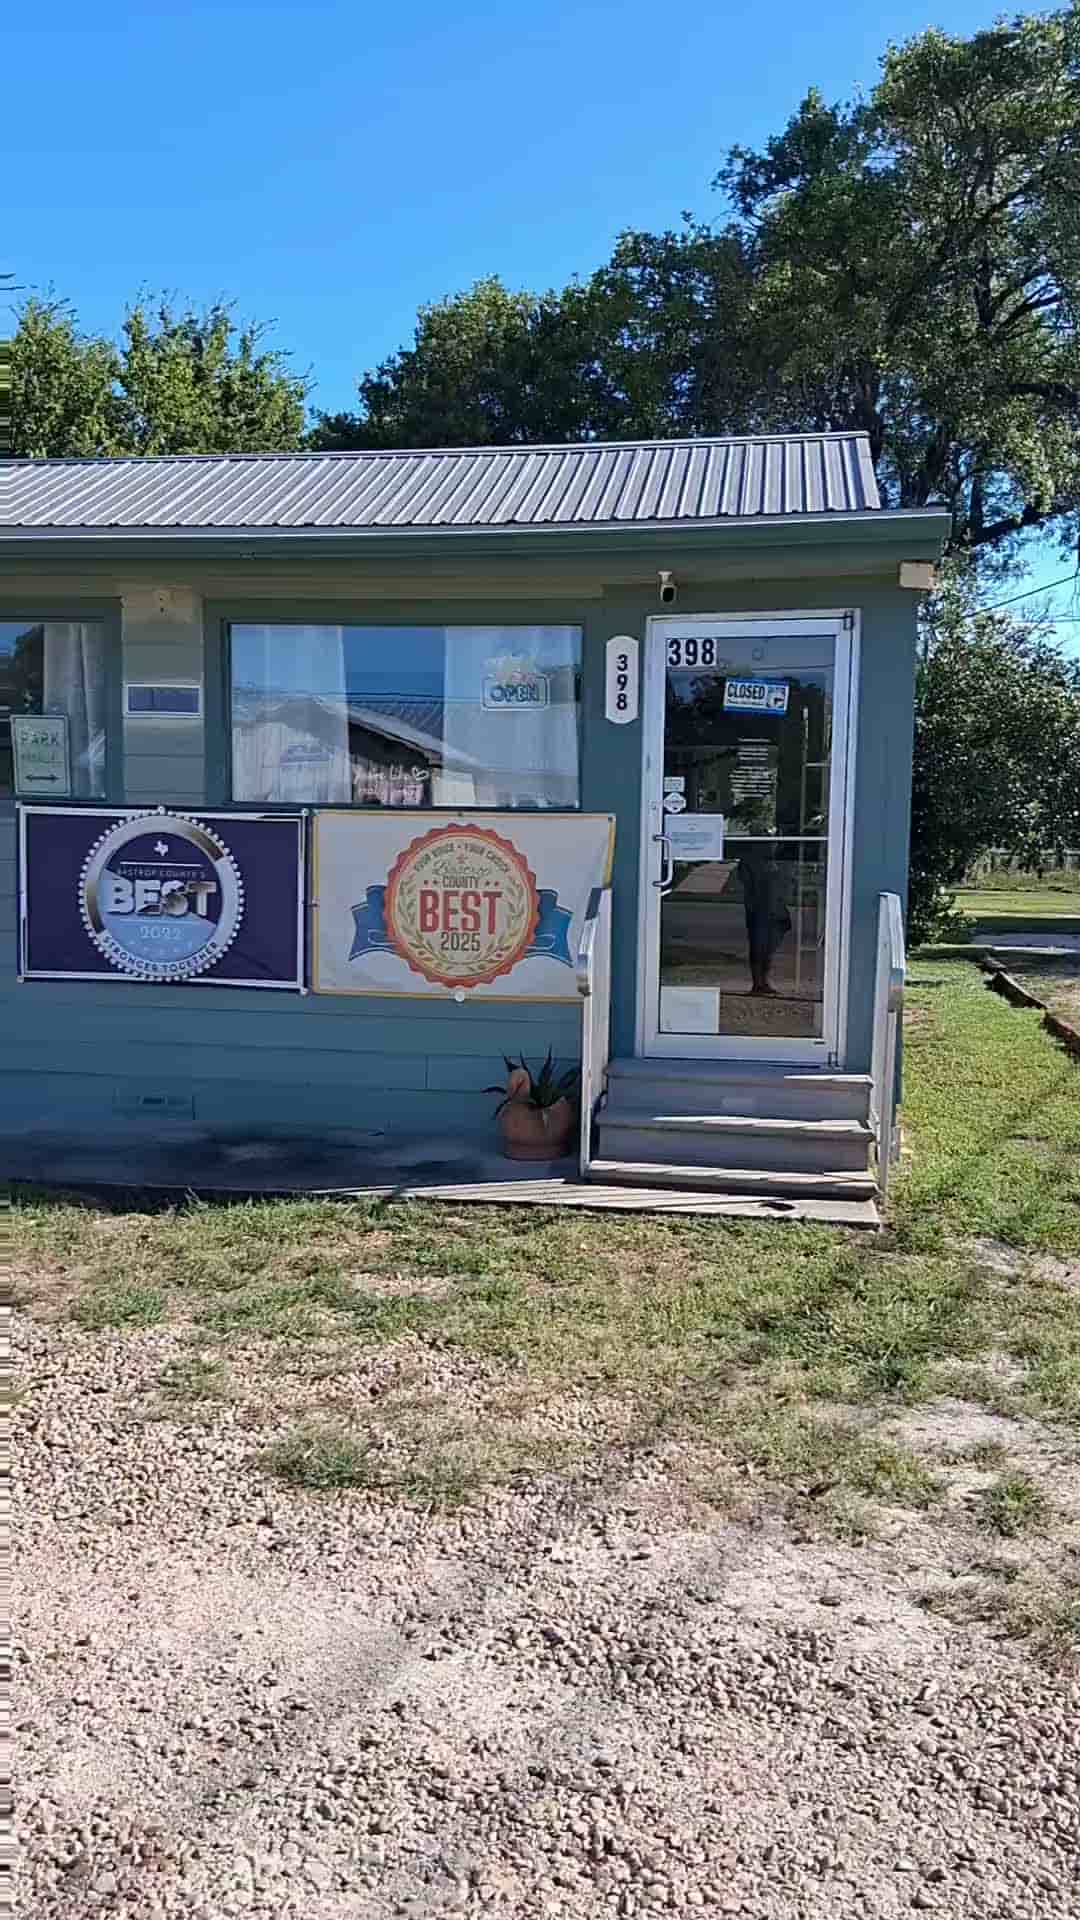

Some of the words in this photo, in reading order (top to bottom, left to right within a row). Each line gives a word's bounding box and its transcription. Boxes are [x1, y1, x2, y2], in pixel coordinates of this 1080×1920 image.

[667, 638, 716, 667] 398
[489, 683, 540, 702] OPEN
[615, 654, 629, 711] 398
[727, 683, 766, 700] CLOSED
[19, 727, 61, 746] PARK
[414, 853, 431, 873] YOUR
[431, 842, 455, 858] VOICE
[463, 842, 485, 856] YOUR
[485, 850, 510, 873] CHOICE
[117, 867, 157, 877] BASTROP
[442, 875, 481, 889] COUNTY
[106, 879, 217, 918] BEST
[419, 889, 502, 935] BEST
[139, 926, 182, 940] 2022
[440, 931, 480, 952] 2025
[102, 935, 158, 970] STRONGER
[163, 941, 217, 972] TOGETHER
